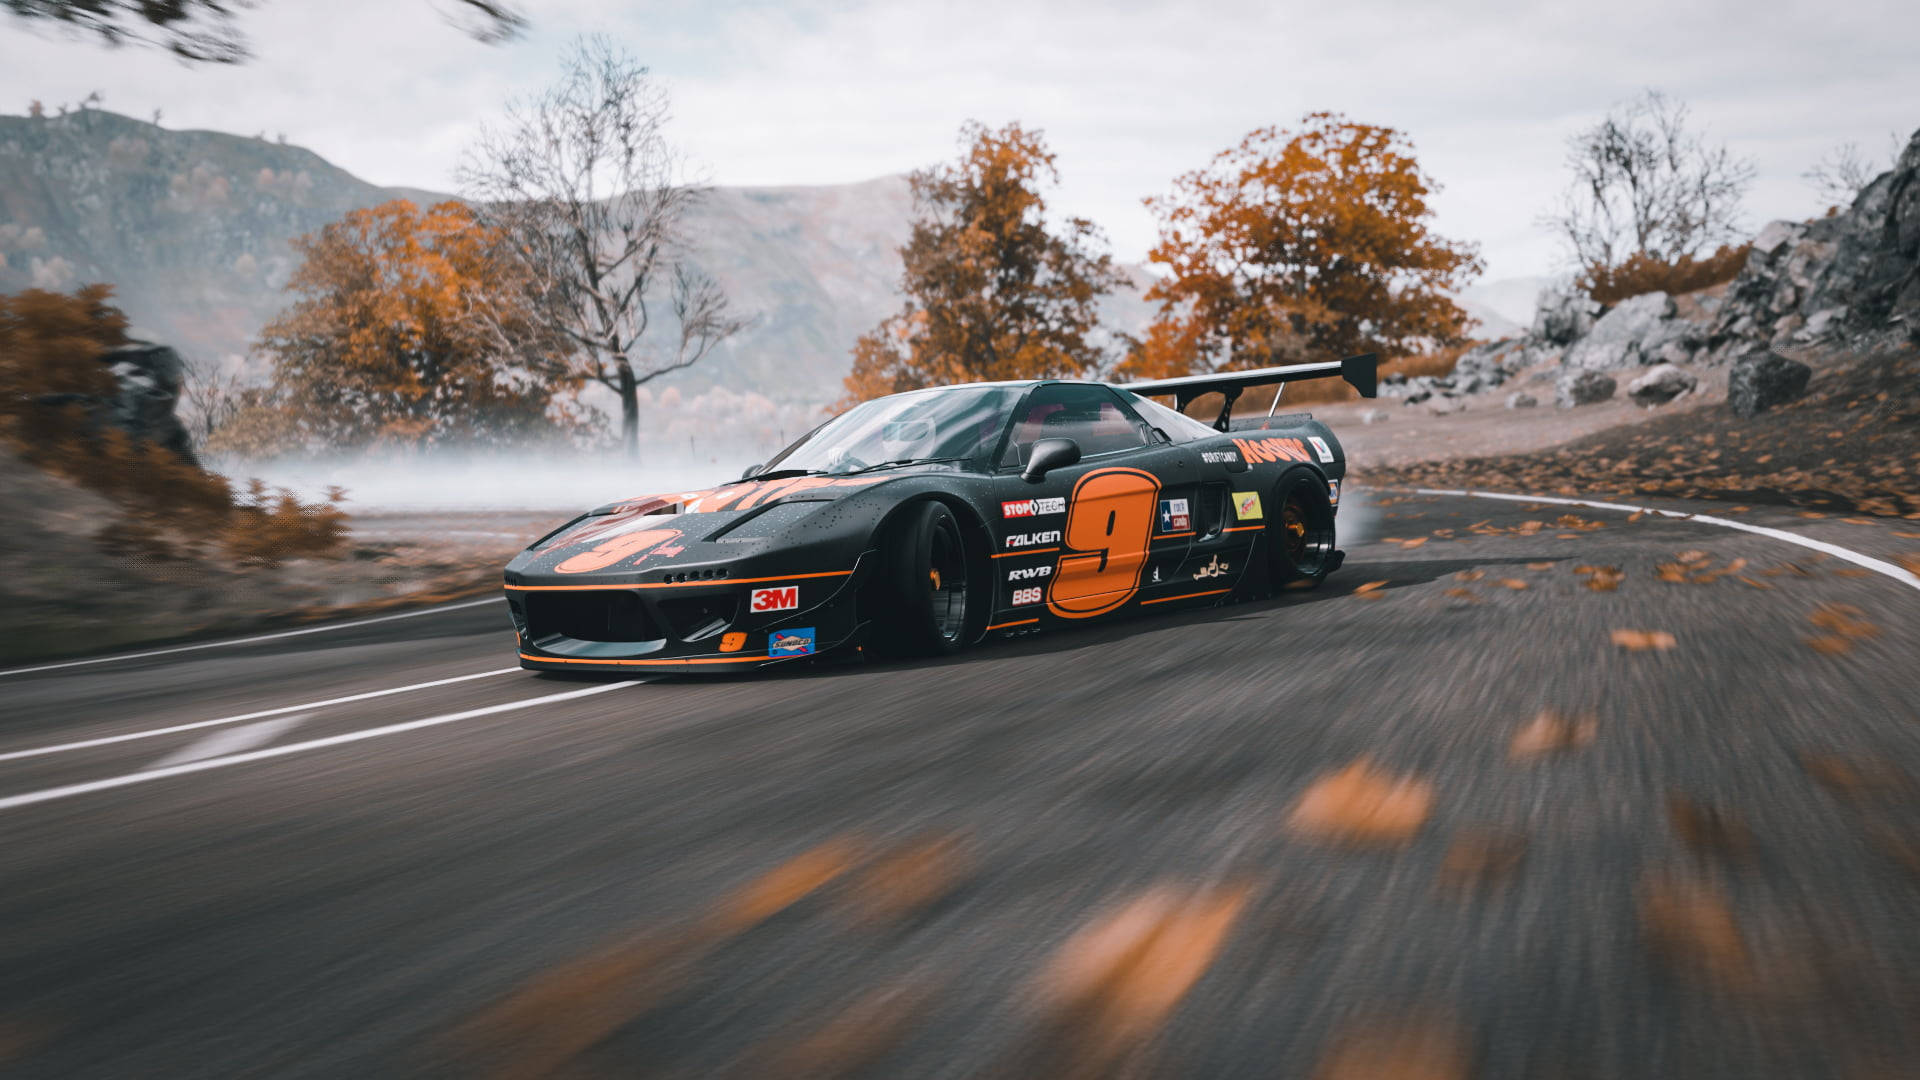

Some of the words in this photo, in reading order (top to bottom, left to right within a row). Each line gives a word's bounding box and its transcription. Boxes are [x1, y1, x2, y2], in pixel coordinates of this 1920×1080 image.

[1232, 438, 1312, 464] HOOS
[1006, 530, 1061, 548] FALKEN
[1046, 467, 1162, 619] 9
[554, 529, 682, 574] 9
[1008, 566, 1052, 581] RWB
[753, 588, 797, 611] 3M
[1012, 587, 1042, 606] BBS
[774, 638, 810, 649] SUNOCO
